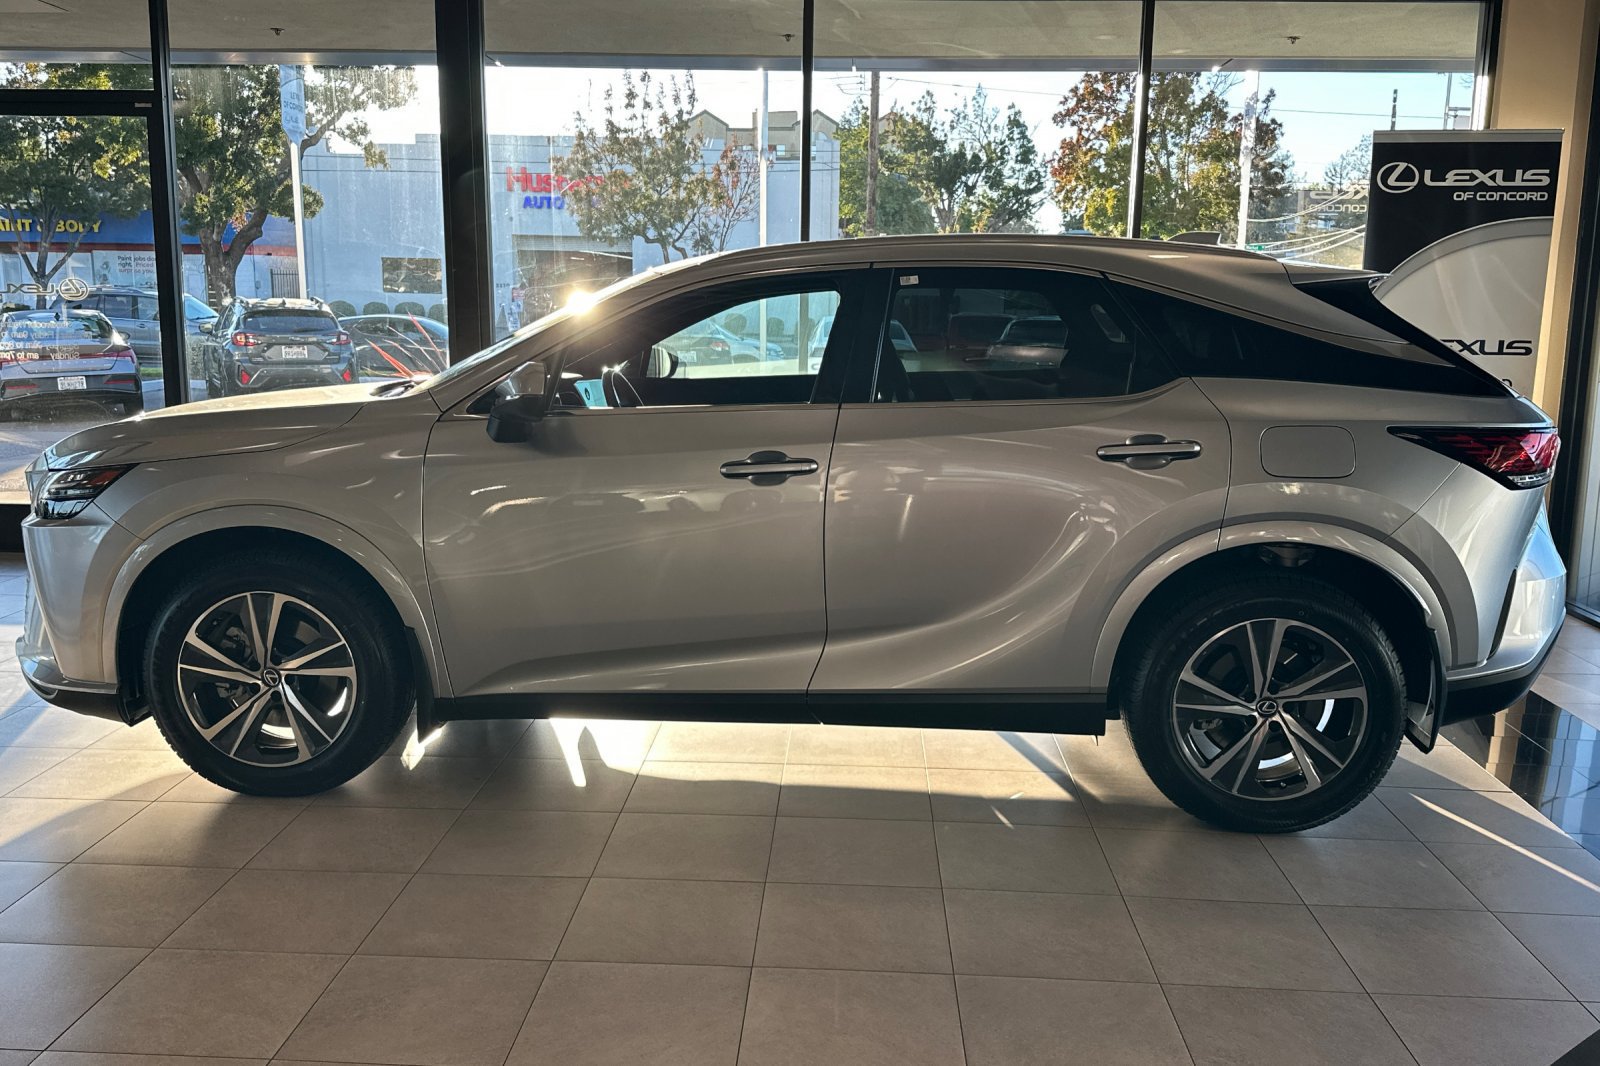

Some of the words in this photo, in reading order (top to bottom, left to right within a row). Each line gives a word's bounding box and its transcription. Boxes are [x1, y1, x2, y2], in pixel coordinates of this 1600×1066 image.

[1424, 169, 1550, 186] LEXUS
[523, 196, 565, 209] AUTO
[1453, 191, 1474, 200] OF
[1476, 191, 1548, 201] CONCORD
